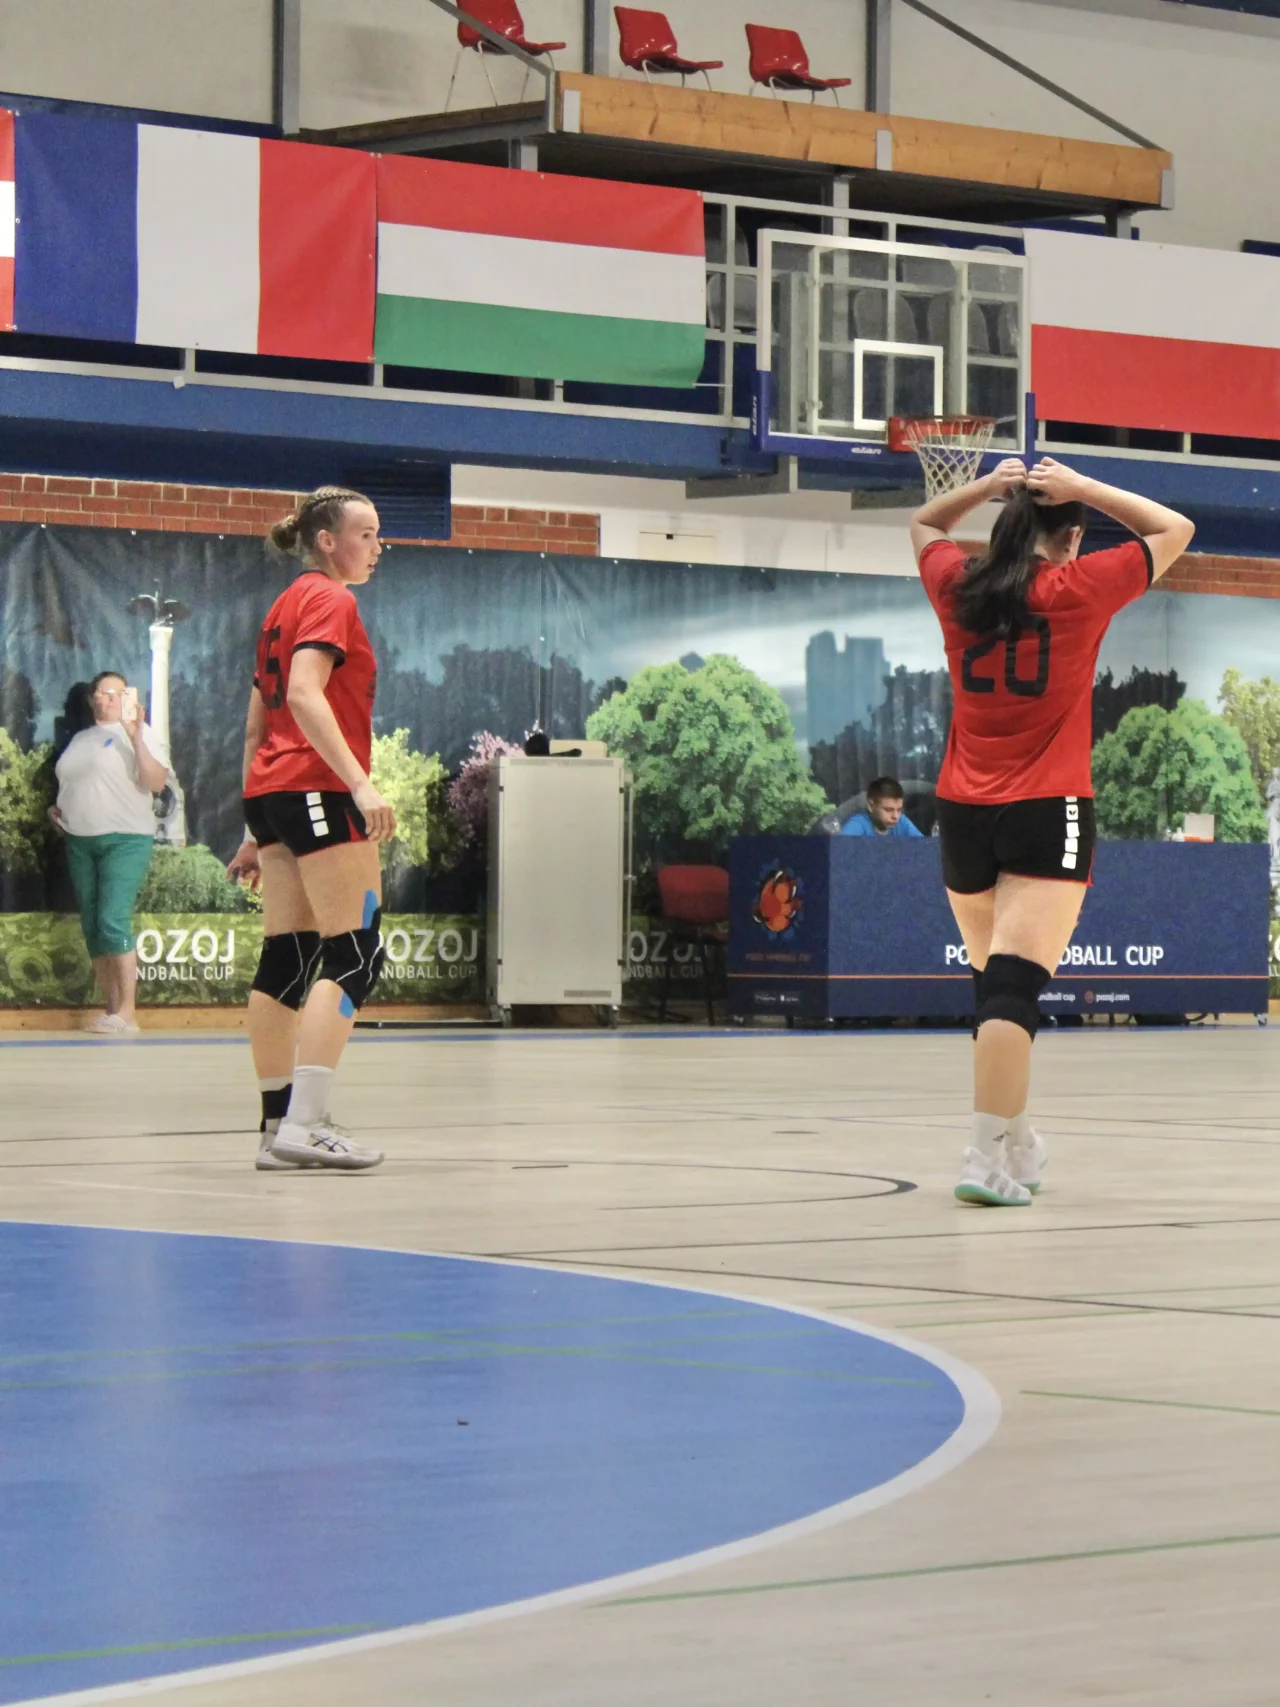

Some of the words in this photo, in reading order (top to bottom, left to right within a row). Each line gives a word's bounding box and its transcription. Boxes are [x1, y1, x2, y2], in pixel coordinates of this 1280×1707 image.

[136, 929, 235, 963] OZOJ
[1059, 946, 1118, 966] DBALL
[1126, 946, 1164, 966] CUP
[136, 966, 198, 980] NDBALL
[204, 966, 235, 980] CUP
[448, 965, 478, 979] CUP
